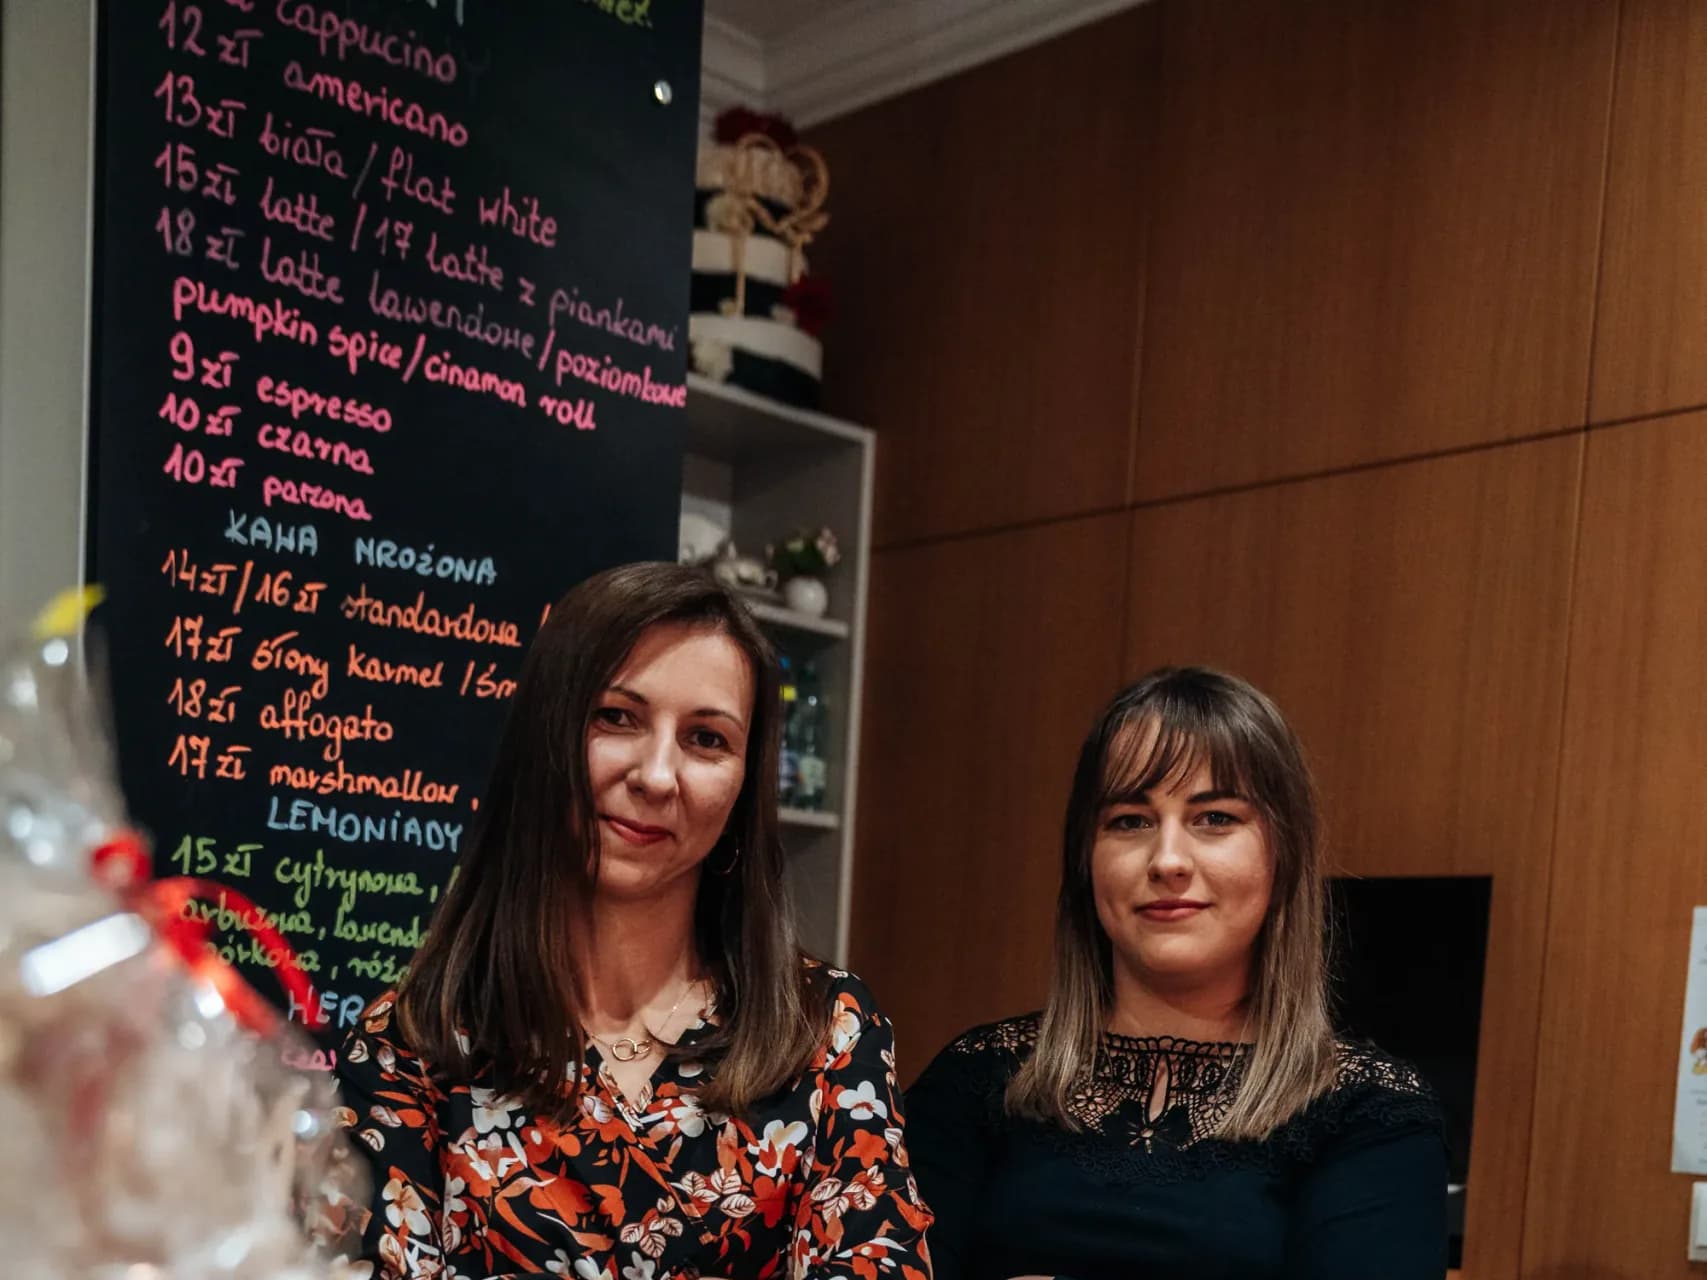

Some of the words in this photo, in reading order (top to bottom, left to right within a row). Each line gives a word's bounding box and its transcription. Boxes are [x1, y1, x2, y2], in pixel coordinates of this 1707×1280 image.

[284, 61, 469, 147] americano
[259, 112, 348, 179] biała
[380, 146, 456, 214] flat
[479, 186, 558, 248] white
[259, 176, 335, 241] latte
[375, 217, 414, 260] 17
[425, 232, 503, 291] latte
[518, 276, 537, 306] z
[549, 287, 679, 352] piankami
[260, 236, 344, 304] latte
[172, 276, 318, 346] pumpkin
[539, 394, 596, 431] roll
[256, 376, 393, 432] espresso
[257, 423, 375, 475] czarna
[262, 475, 373, 521] parzona
[224, 508, 318, 557] KAWA
[354, 537, 497, 586] MROŻONA
[339, 582, 522, 648] standardowa
[251, 630, 330, 700] słony
[346, 643, 444, 689] karmel
[259, 687, 394, 762] affogato
